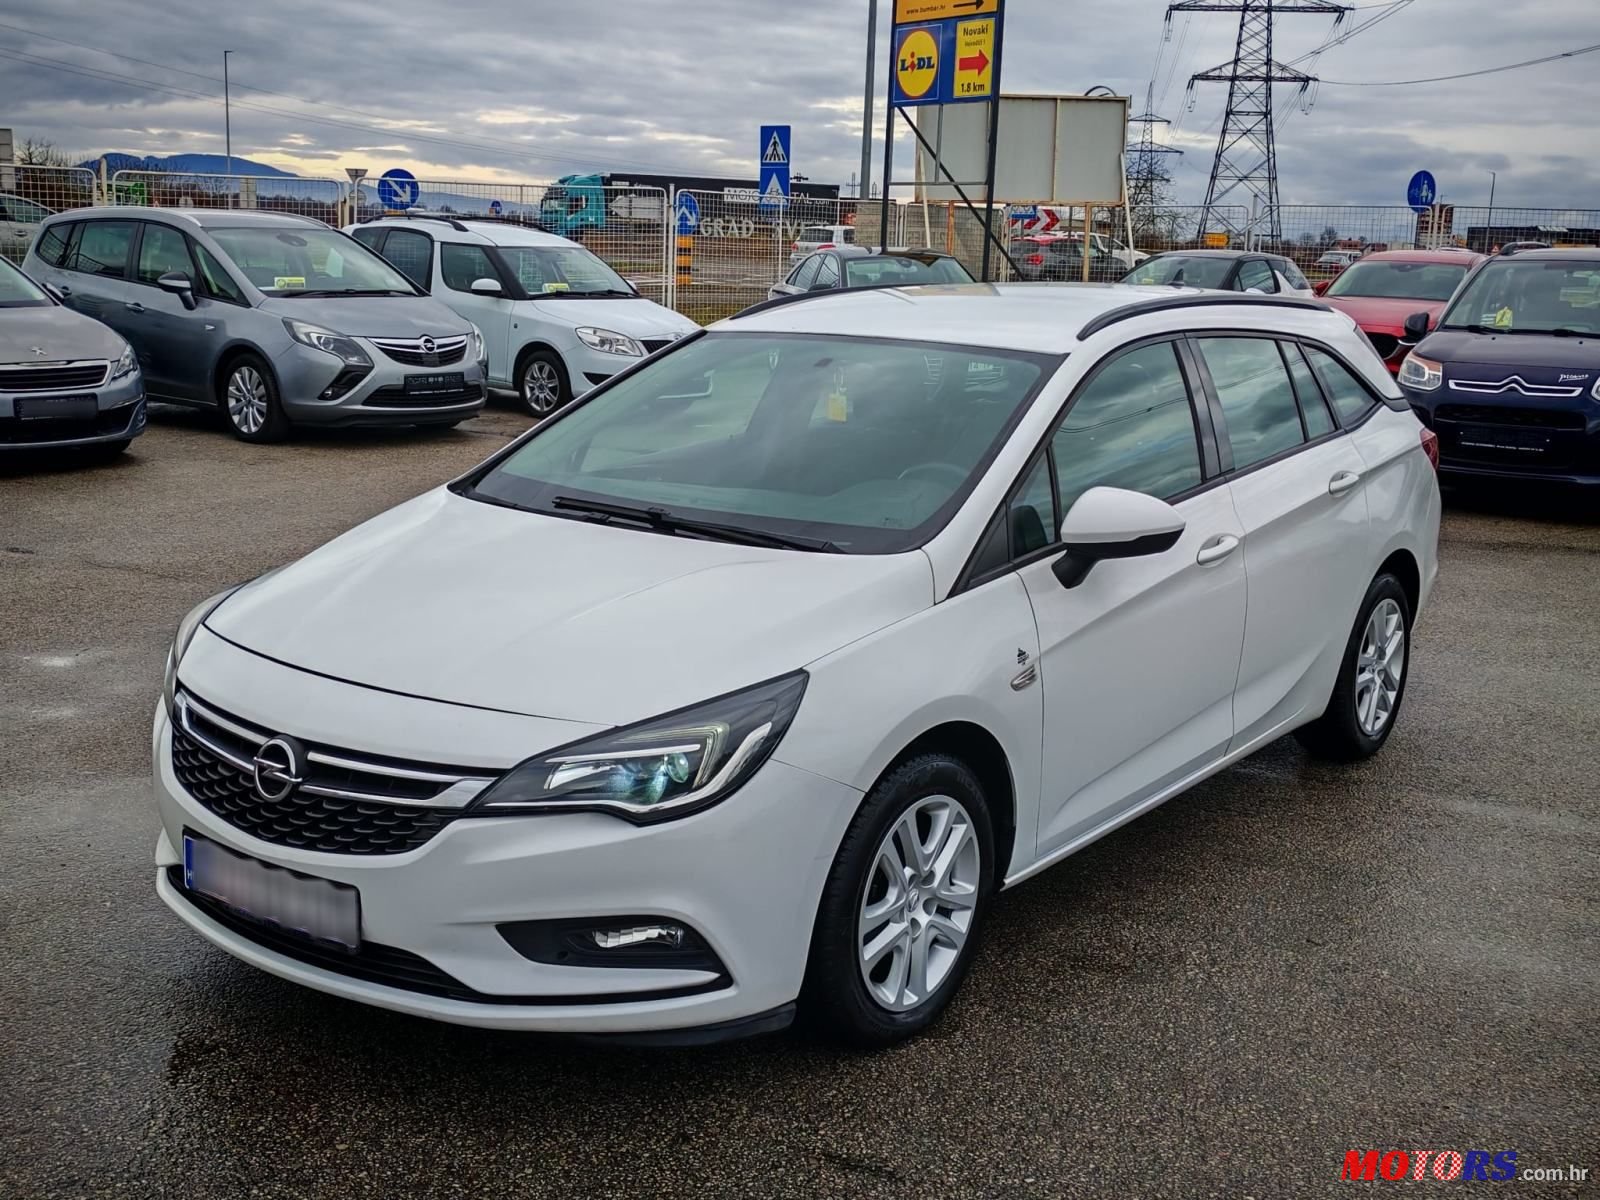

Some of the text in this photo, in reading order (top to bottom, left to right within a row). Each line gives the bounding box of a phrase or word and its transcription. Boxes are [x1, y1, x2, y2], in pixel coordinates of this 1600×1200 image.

[961, 82, 985, 92] 1.8 km
[700, 218, 754, 238] GRAD
